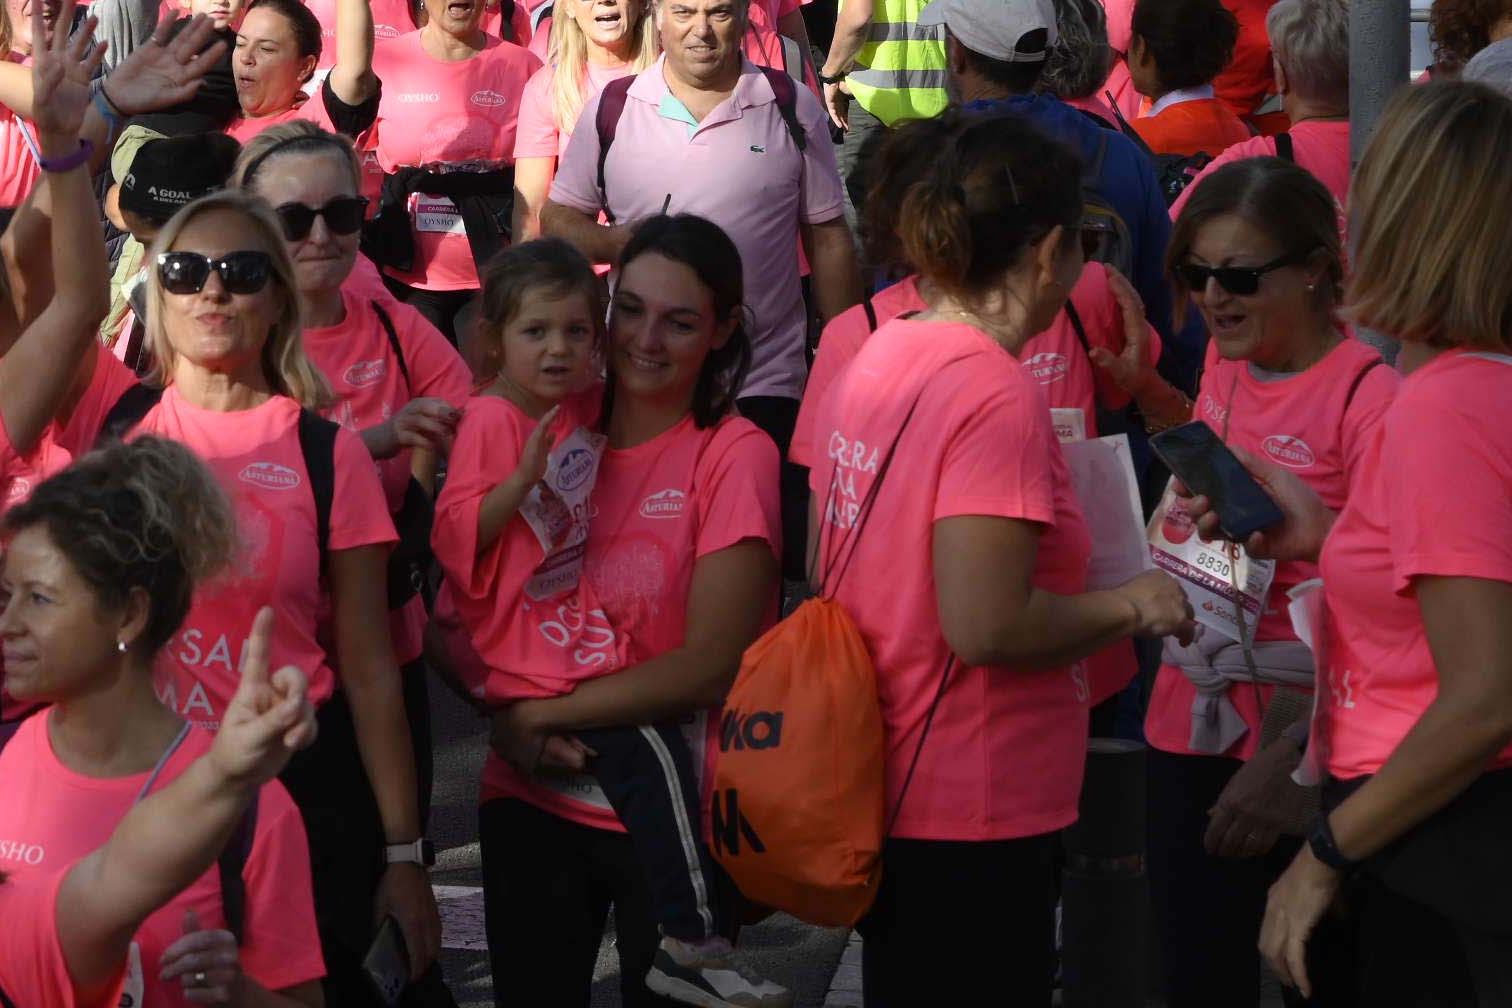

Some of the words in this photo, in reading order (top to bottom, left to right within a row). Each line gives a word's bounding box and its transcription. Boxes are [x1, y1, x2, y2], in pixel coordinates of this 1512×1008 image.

[159, 189, 192, 200] GOAL
[246, 471, 298, 486] ASTURIANA
[1196, 552, 1230, 577] 8830
